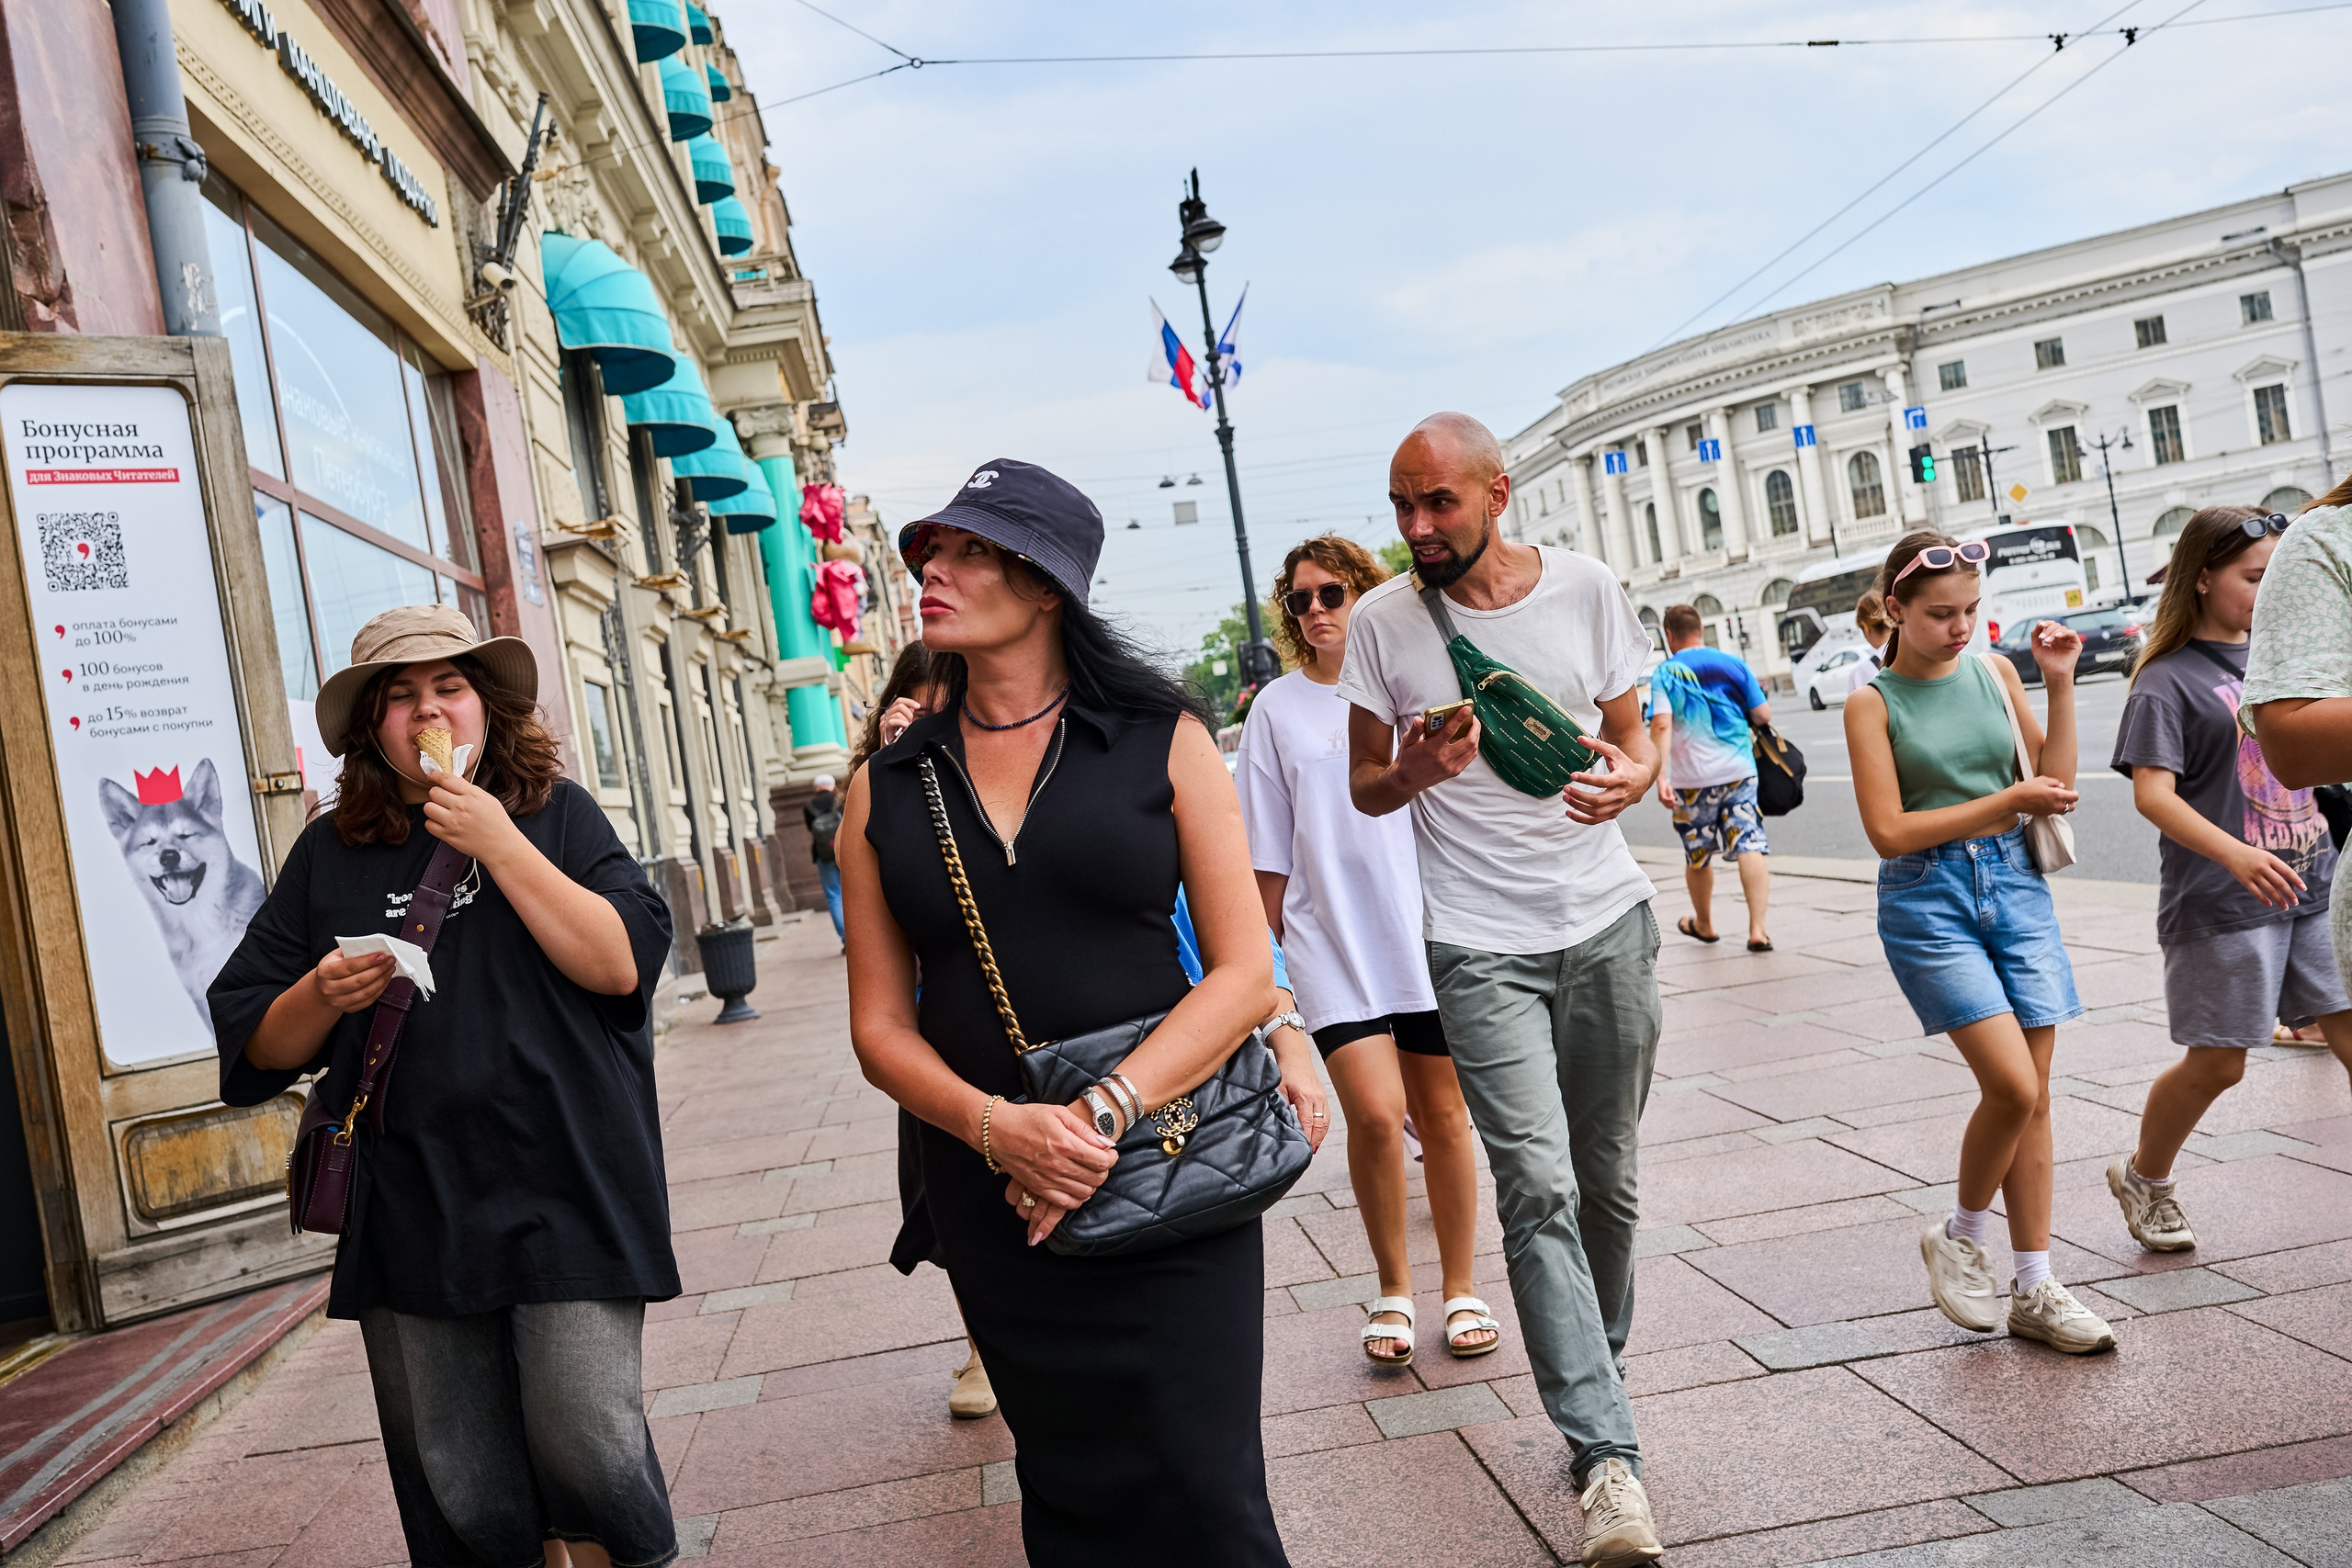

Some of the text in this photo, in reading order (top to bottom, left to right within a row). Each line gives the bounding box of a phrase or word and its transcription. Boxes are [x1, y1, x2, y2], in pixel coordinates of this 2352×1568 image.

[20, 420, 139, 442] Бонусная
[25, 445, 164, 464] программа
[28, 468, 175, 483] для Знаковых Читателей
[73, 616, 178, 631] оплата бонусами
[75, 629, 137, 648] до 100%
[79, 660, 164, 677] 100 бонусов
[83, 675, 190, 693] в день рождения
[87, 705, 188, 724] до 15% возврат
[89, 718, 214, 739] бонусами с покупки
